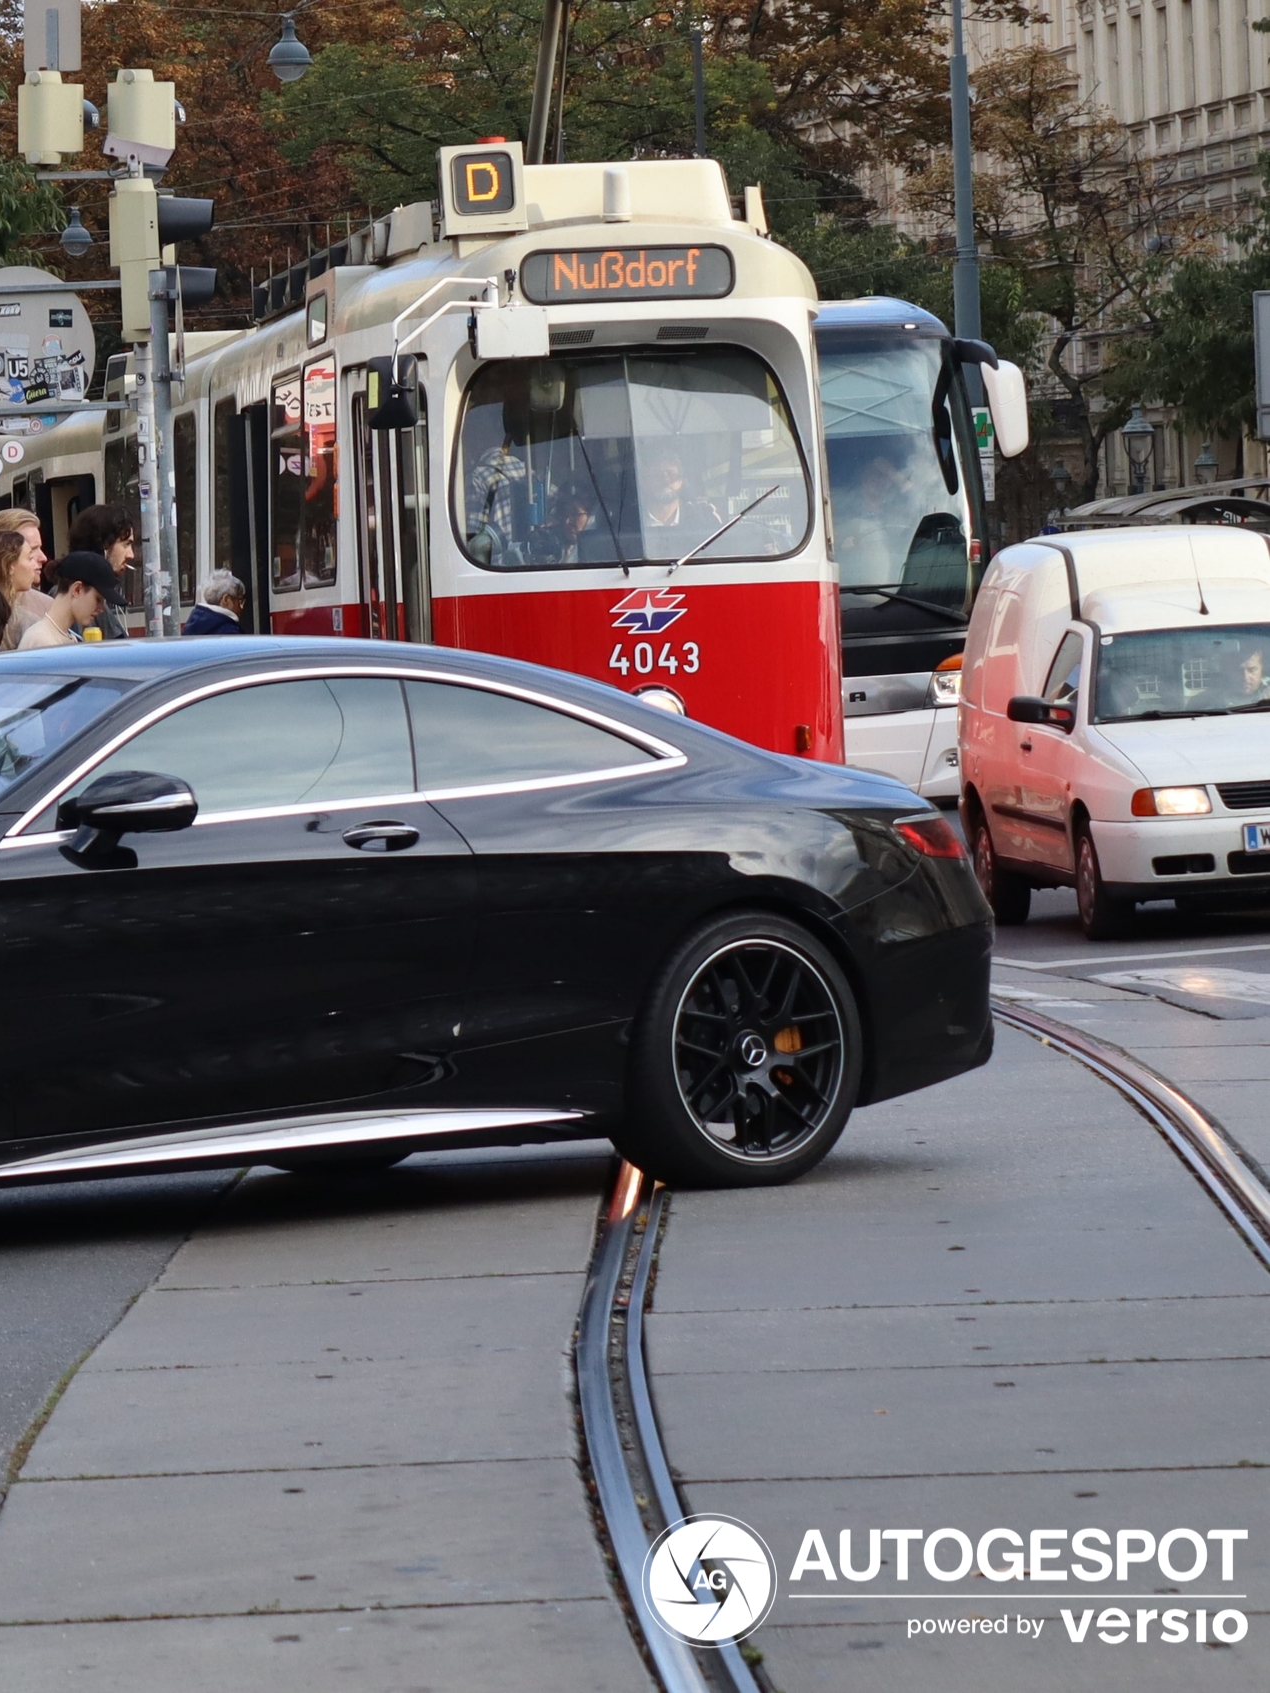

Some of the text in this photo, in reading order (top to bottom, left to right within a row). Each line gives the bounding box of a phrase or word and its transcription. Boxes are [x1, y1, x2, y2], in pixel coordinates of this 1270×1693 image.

[466, 162, 499, 201] D
[554, 248, 701, 291] Nußdorf
[9, 360, 28, 378] U5
[8, 446, 18, 459] D
[609, 642, 700, 676] 4043
